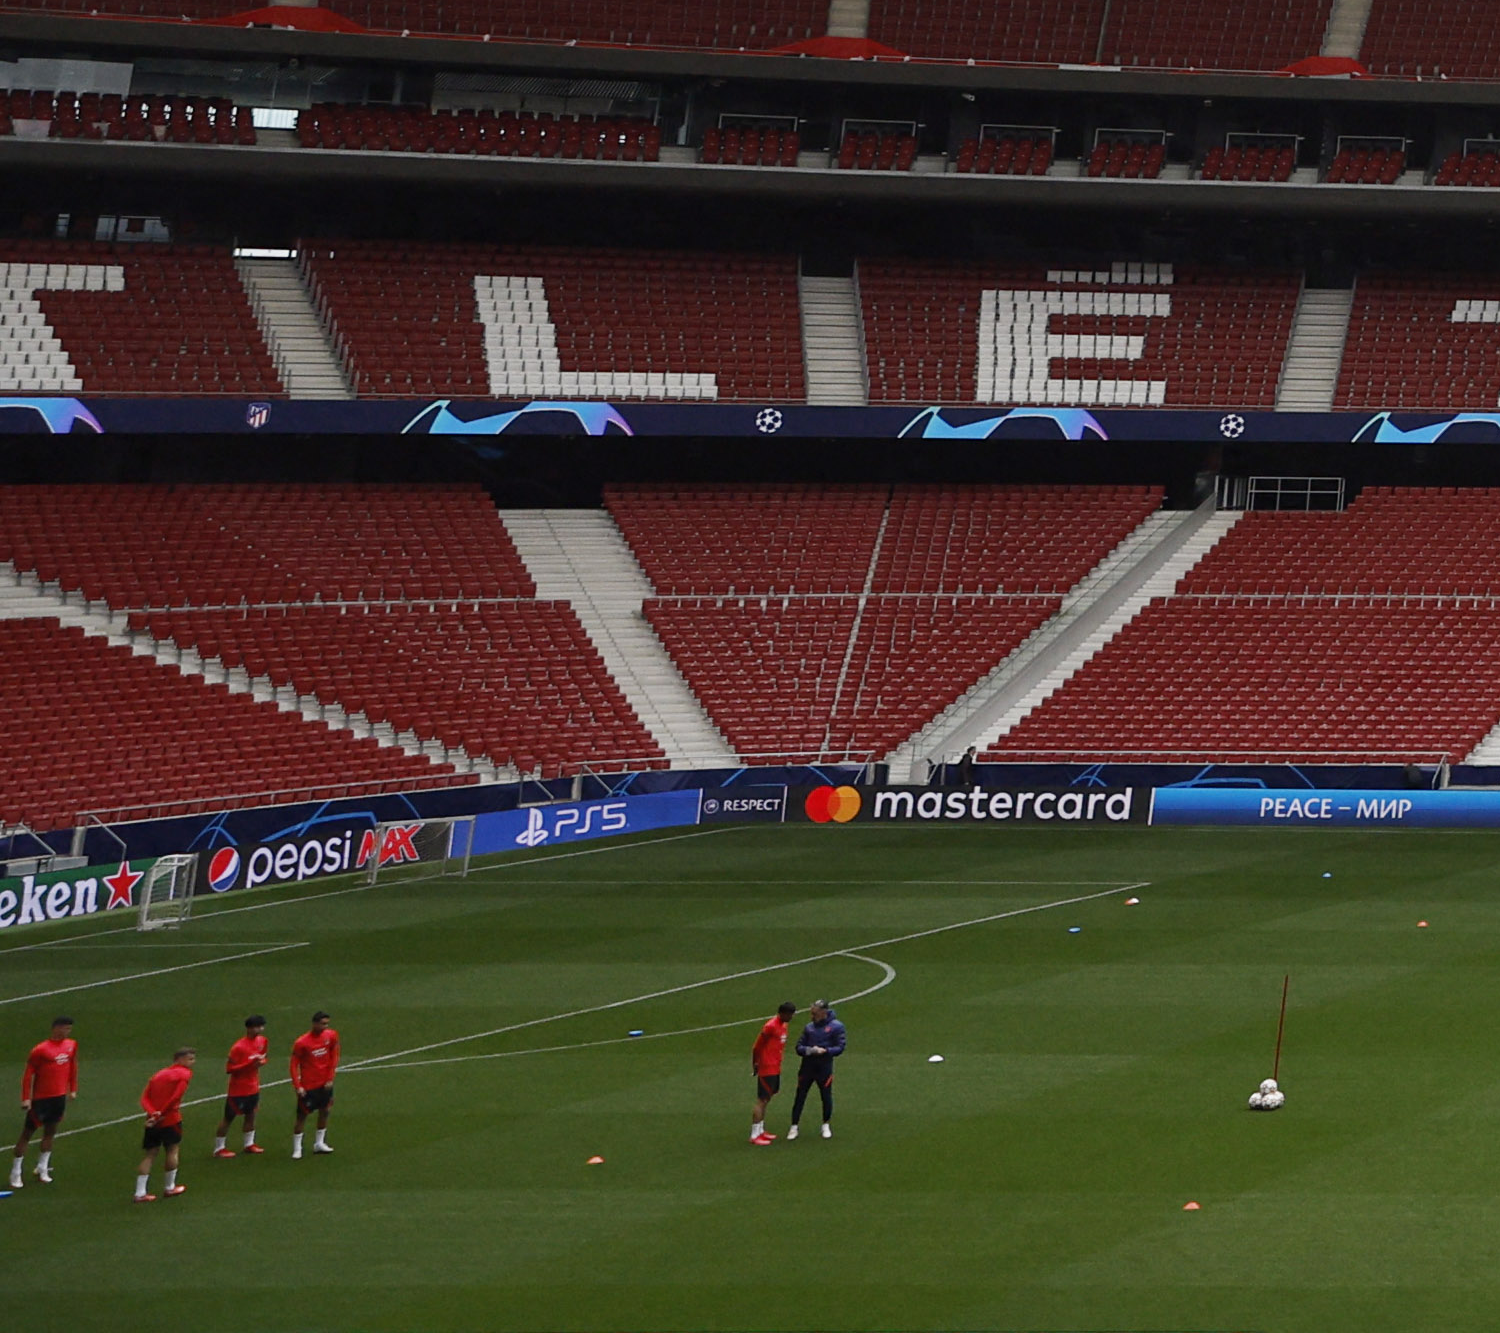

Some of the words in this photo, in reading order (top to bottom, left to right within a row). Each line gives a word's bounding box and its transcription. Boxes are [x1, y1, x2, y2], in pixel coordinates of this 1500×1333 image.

[555, 802, 628, 836] PS5
[723, 798, 781, 812] RESPECT
[873, 787, 1133, 822] mastercard
[1260, 797, 1332, 819] PEACE
[246, 830, 352, 889] pepsi
